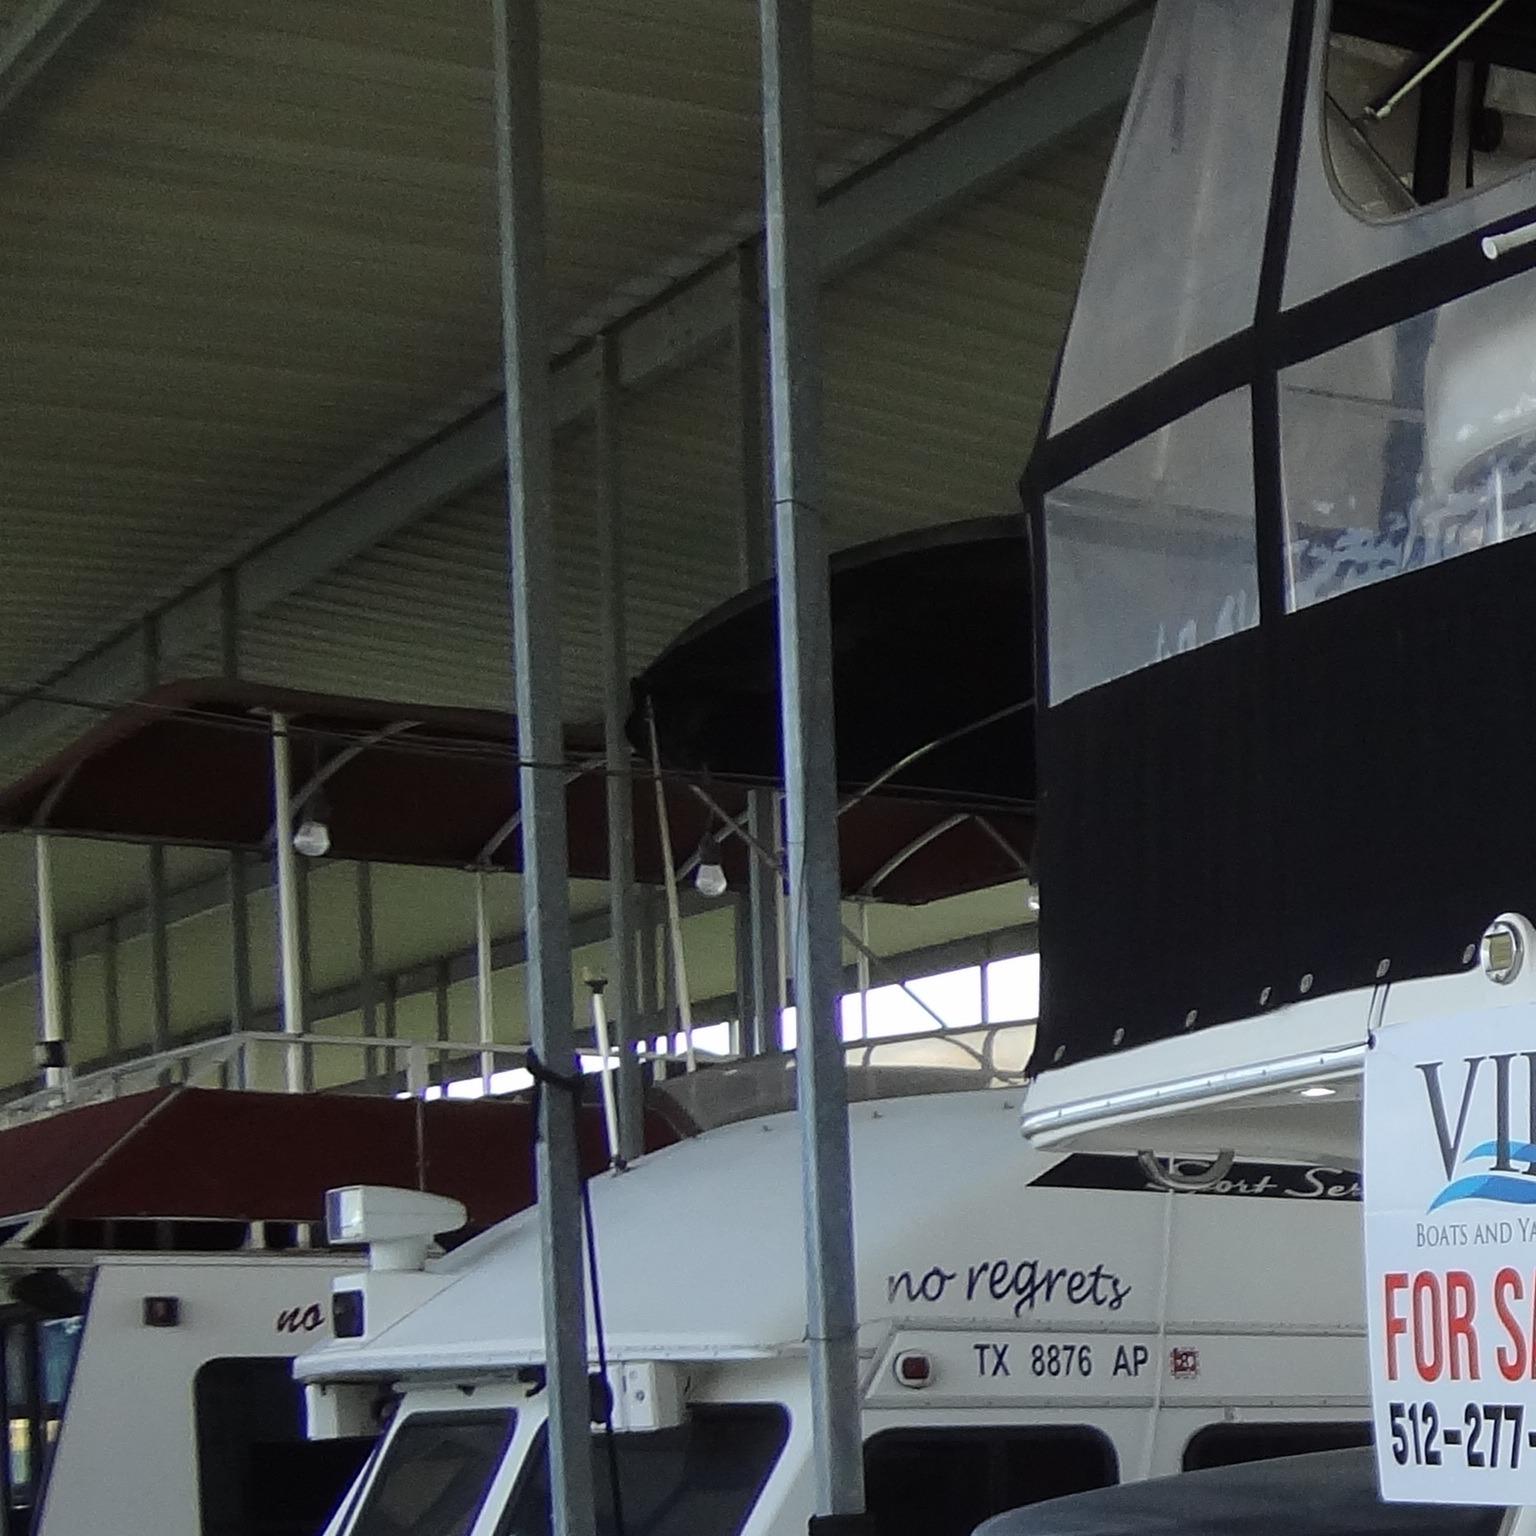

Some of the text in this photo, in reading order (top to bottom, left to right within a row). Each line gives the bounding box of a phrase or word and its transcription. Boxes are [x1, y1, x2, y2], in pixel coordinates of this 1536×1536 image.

[1416, 1221, 1468, 1248] BOATS
[1473, 1220, 1513, 1246] AND
[887, 1258, 1132, 1318] no regrets
[276, 1302, 326, 1333] no
[1383, 1269, 1481, 1384] FOR
[973, 1343, 1010, 1377] TX
[1030, 1344, 1093, 1378] 8876
[1112, 1344, 1149, 1378] AP
